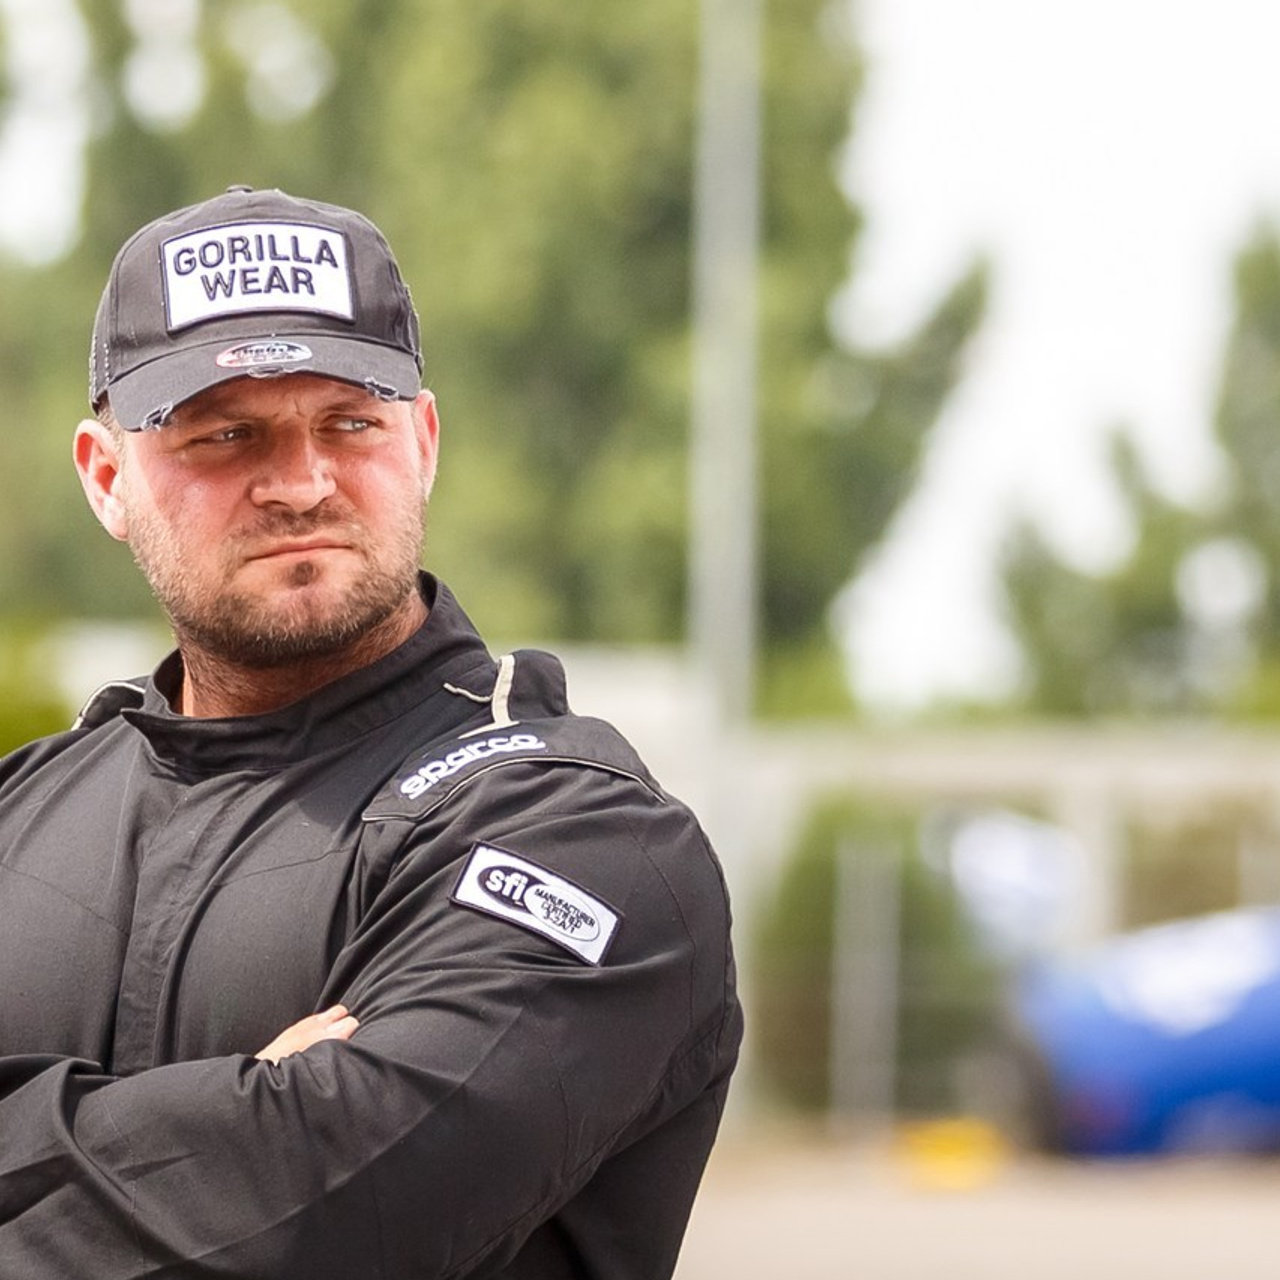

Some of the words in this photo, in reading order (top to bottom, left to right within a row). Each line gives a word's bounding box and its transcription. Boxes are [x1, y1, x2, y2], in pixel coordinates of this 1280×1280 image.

[173, 234, 339, 276] GORILLA
[200, 266, 316, 301] WEAR
[534, 888, 596, 928] MANUFACTURER
[541, 901, 582, 929] CERTIFIED
